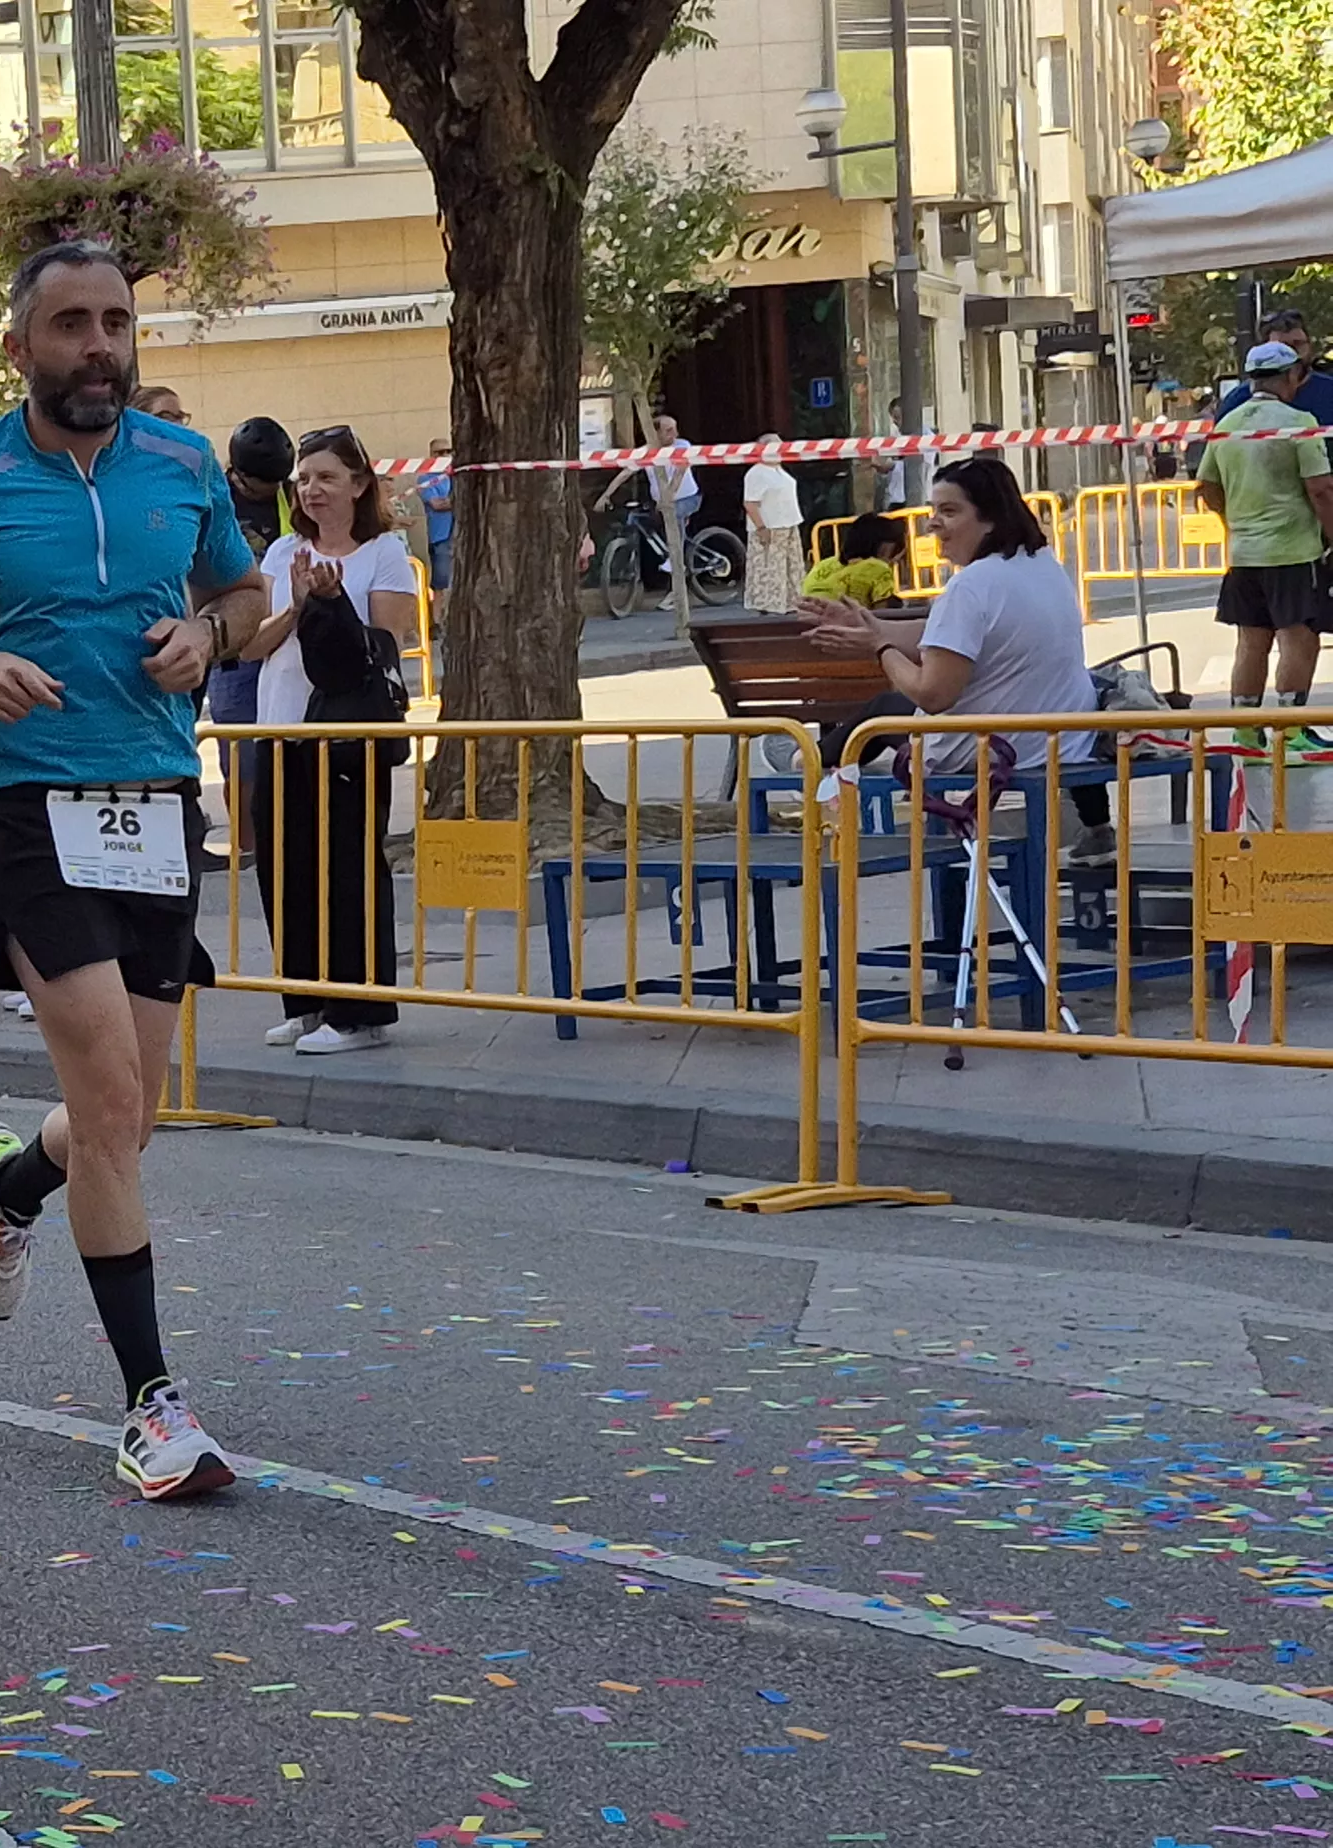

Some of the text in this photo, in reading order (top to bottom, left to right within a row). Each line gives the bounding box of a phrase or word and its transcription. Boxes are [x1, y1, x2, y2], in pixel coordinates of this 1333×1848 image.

[380, 302, 424, 325] ANITA
[97, 808, 141, 836] 26
[869, 796, 884, 834] 1
[103, 841, 143, 852] JORGE
